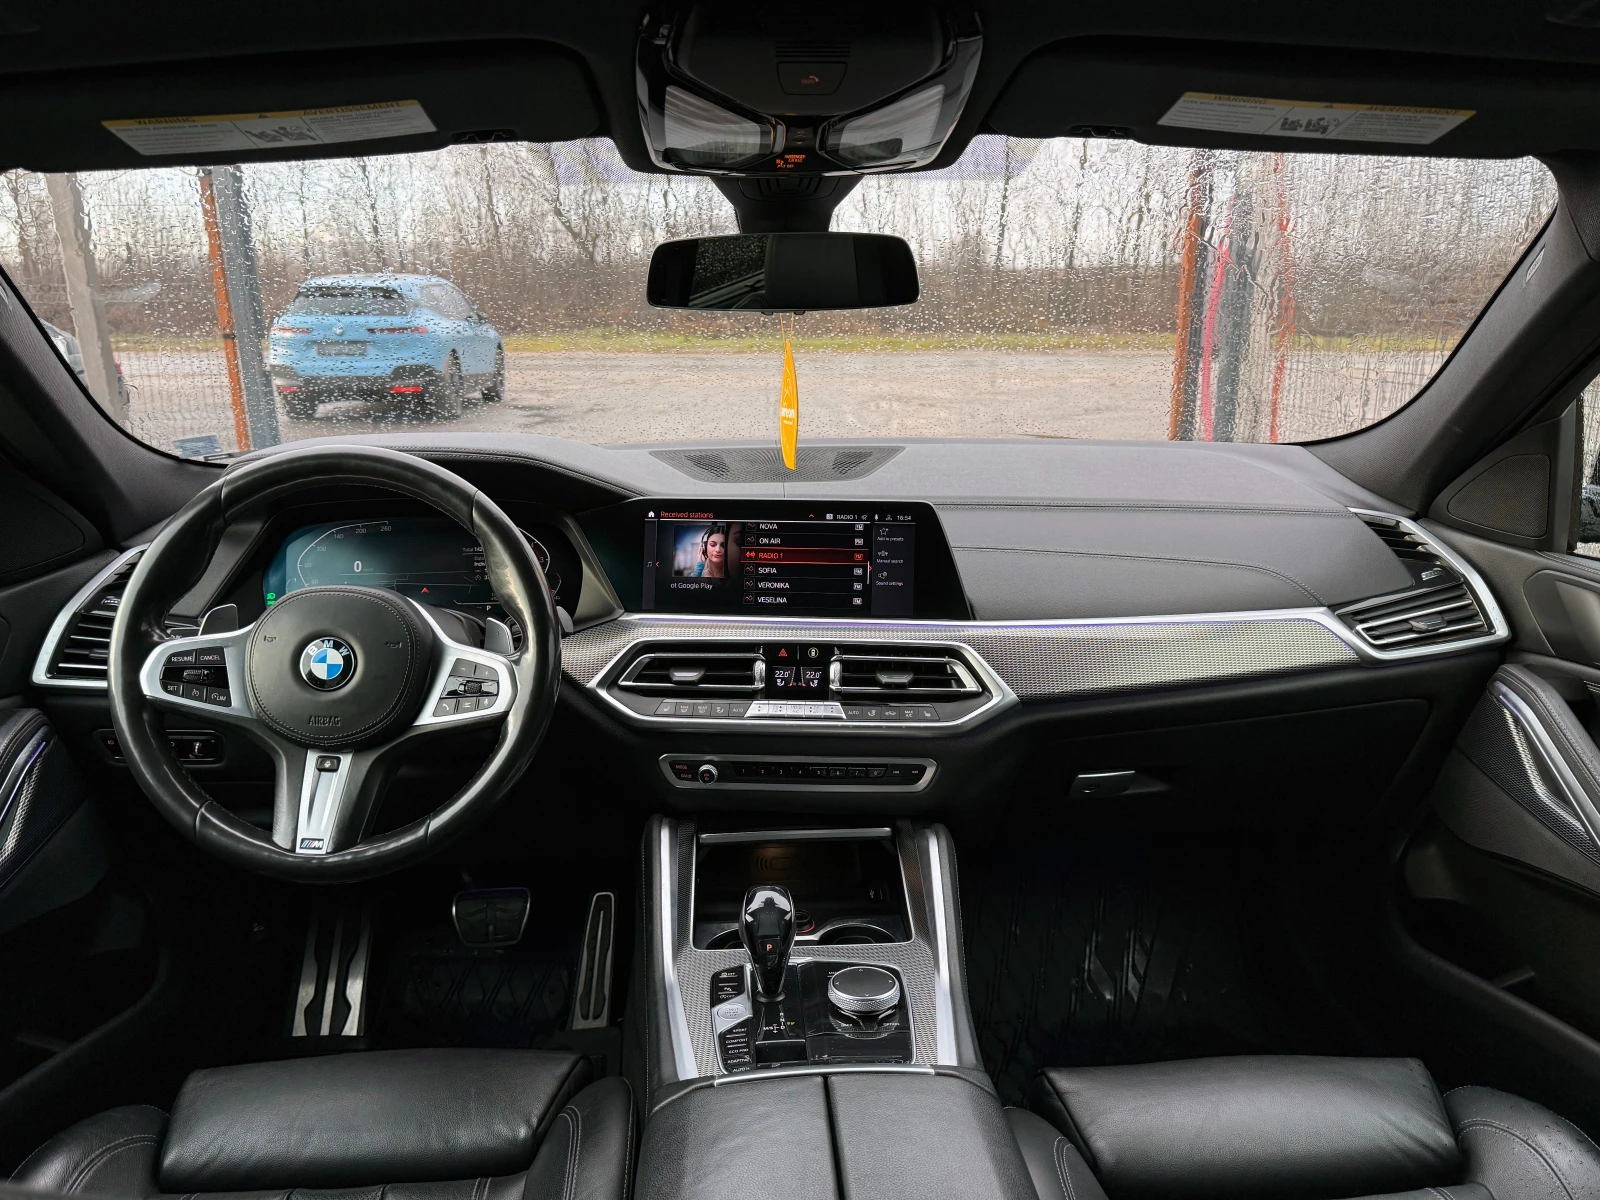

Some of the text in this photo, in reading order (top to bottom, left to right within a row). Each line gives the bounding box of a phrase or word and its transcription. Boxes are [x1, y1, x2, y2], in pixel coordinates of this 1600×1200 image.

[1213, 95, 1267, 104] WARNING
[303, 102, 402, 116] AVERTISSEMENT
[353, 560, 362, 572] 0
[700, 582, 713, 590] Play
[757, 596, 788, 604] VESELINA
[307, 639, 350, 656] BMW
[308, 715, 341, 726] AIRBAG
